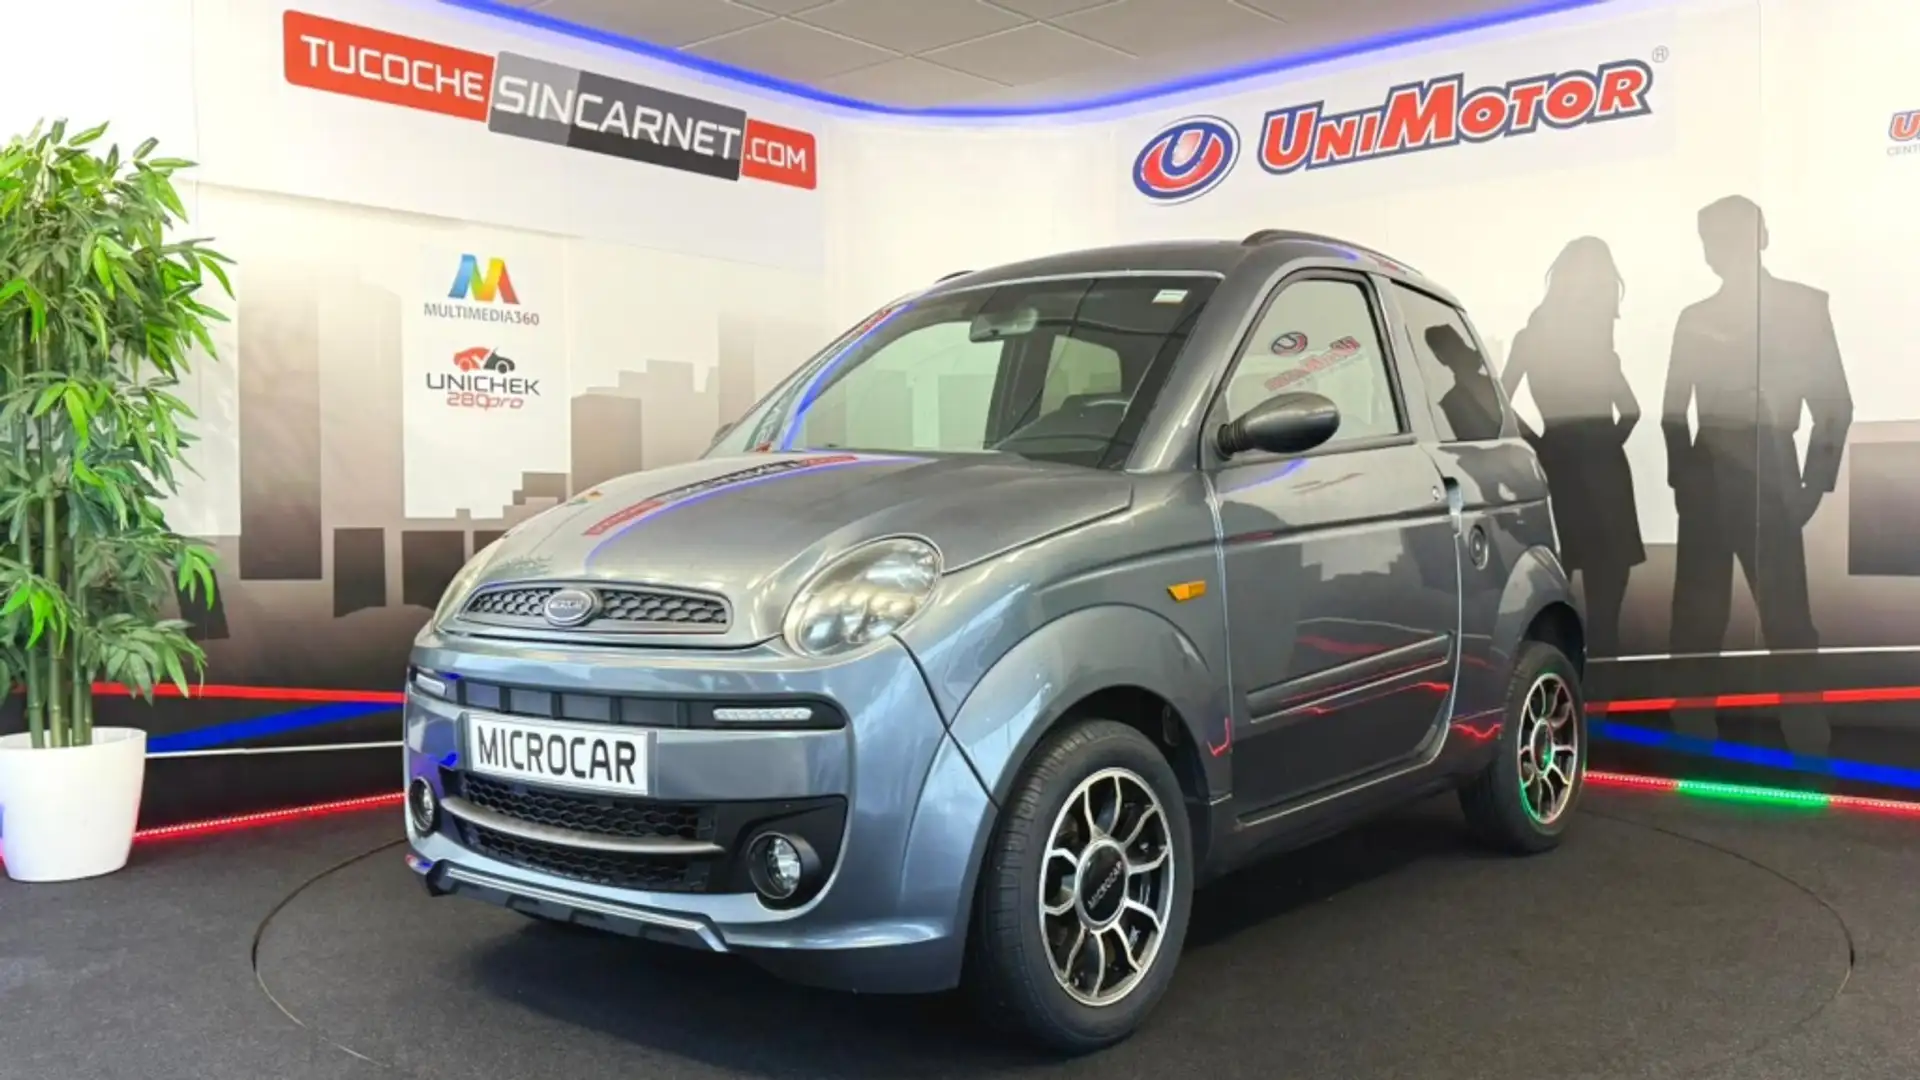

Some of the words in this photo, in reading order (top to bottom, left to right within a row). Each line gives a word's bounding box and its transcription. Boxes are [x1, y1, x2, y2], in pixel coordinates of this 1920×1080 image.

[300, 33, 485, 102] TUCOCHE
[494, 76, 741, 160] SINCARNET
[745, 136, 807, 173] .COM
[1259, 60, 1652, 174] UNIMOTOR
[1889, 109, 1920, 141] U
[423, 302, 540, 326] MULTIMEDIA360
[425, 371, 542, 396] UNICHEK
[477, 724, 637, 785] MICROCAR
[1087, 860, 1122, 909] MICROCAR
